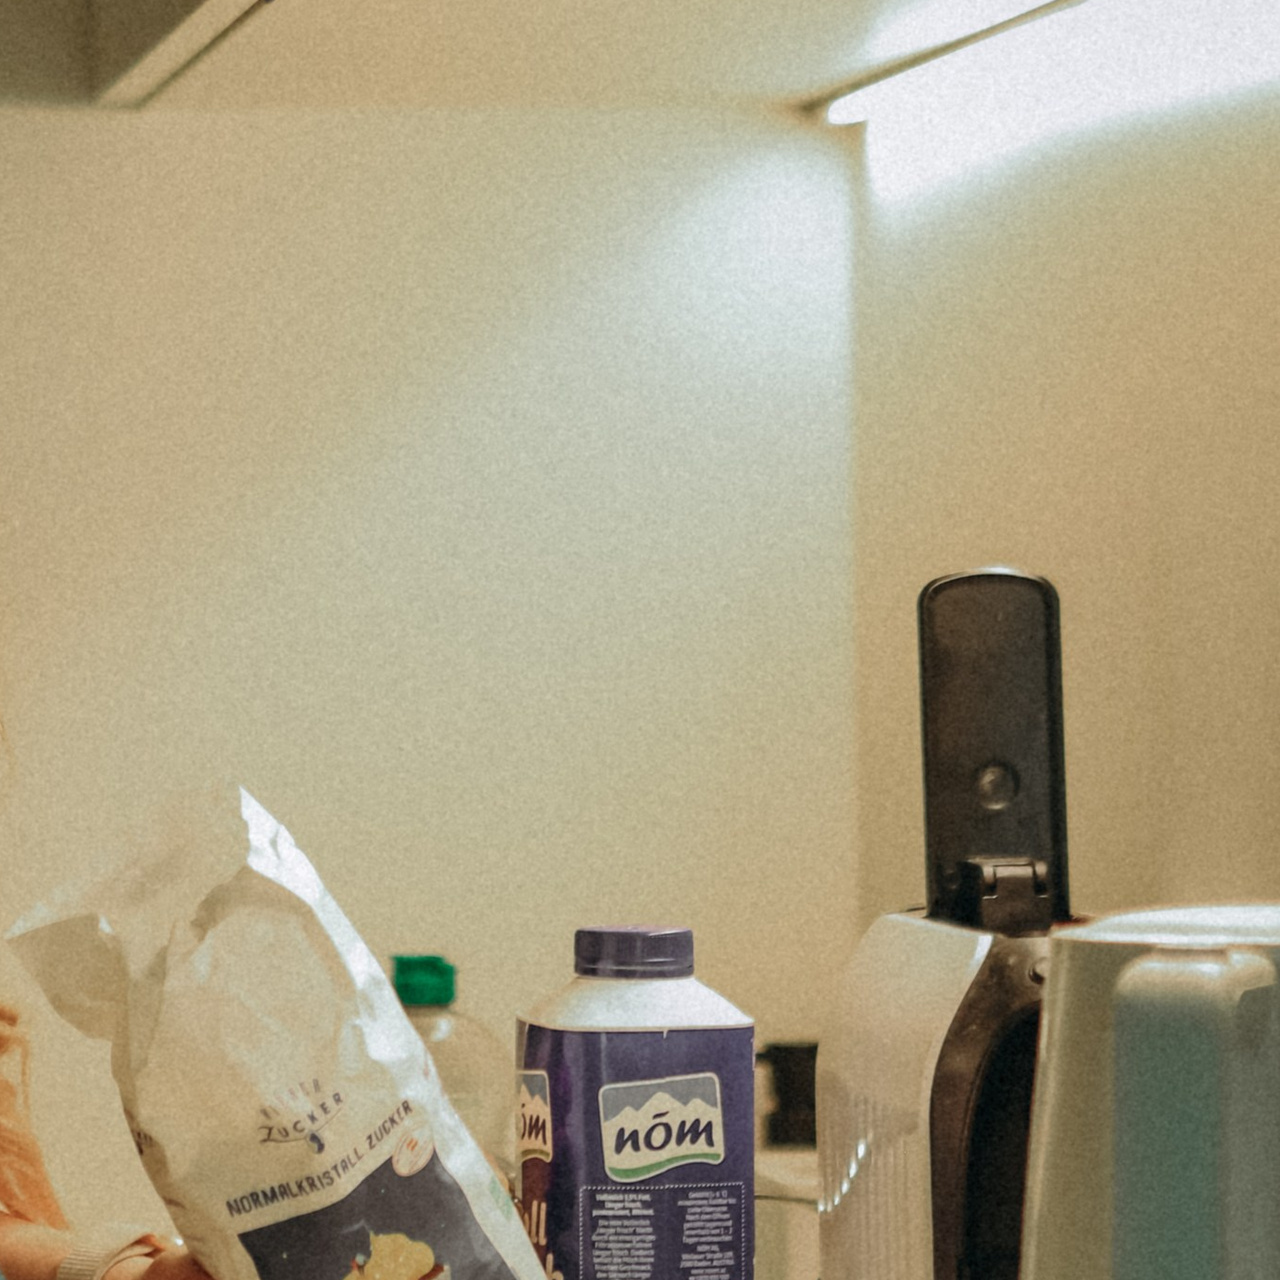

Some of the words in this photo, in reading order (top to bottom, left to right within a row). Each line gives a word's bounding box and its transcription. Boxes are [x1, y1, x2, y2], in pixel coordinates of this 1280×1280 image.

[225, 1147, 365, 1218] NORMALKRISTALL
[365, 1099, 414, 1151] ZUCKER
[258, 1092, 344, 1144] ZUCKER
